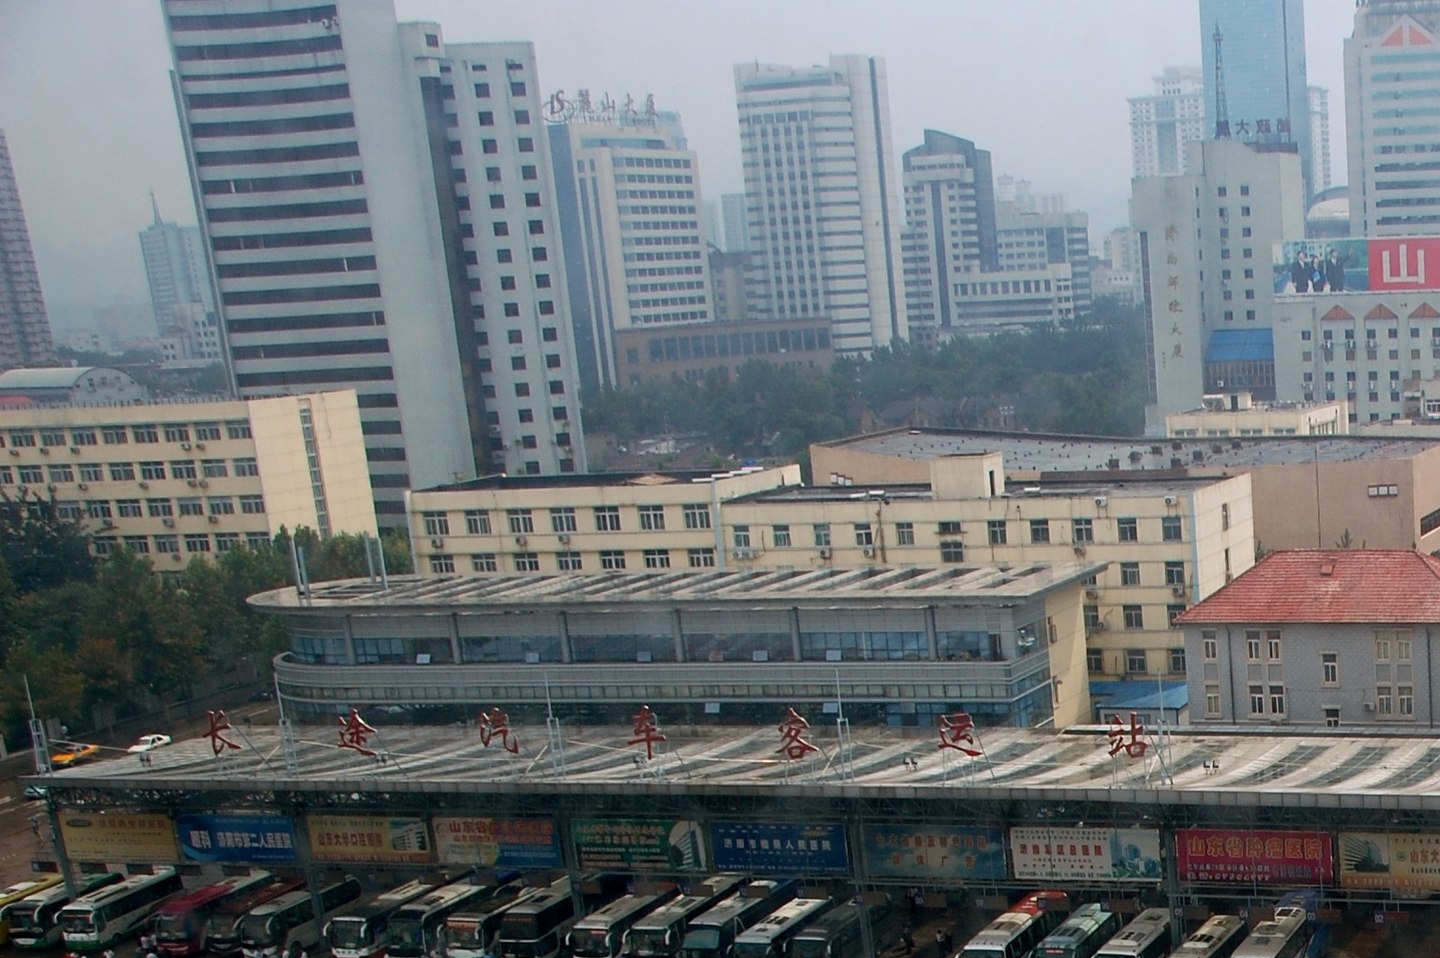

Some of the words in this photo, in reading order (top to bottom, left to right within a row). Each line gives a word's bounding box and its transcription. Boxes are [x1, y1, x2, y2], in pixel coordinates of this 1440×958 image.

[203, 704, 1148, 761] 长途汽车客运站
[1188, 836, 1323, 860] 山东省肿瘤医院
